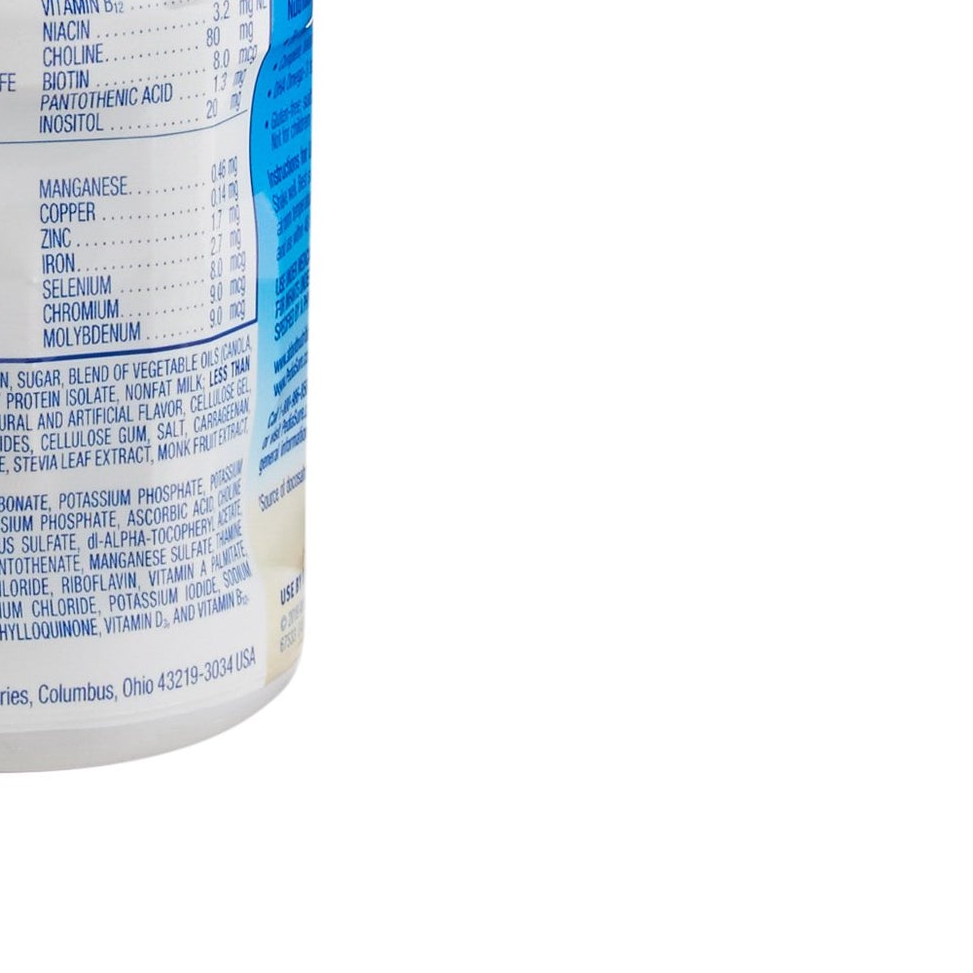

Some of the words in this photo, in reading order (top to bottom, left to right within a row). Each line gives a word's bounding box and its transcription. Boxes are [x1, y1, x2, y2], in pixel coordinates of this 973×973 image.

[43, 20, 90, 42] NIACIN
[43, 44, 103, 67] CHOLINE
[206, 27, 220, 47] 80
[43, 70, 90, 91] BIOTIN
[40, 89, 138, 111] PANTOTHENIC
[141, 83, 173, 103] ACID
[39, 114, 104, 133] INOSITOL
[206, 100, 218, 119] 20
[39, 176, 128, 198] MANGANESE
[40, 202, 95, 223] COPPER
[41, 228, 71, 249] ZINC
[42, 253, 75, 274] IRON
[43, 275, 111, 300] SELENIUM
[43, 299, 119, 324] CHROMIUM
[43, 322, 140, 348] MOLYBDENUM
[17, 369, 64, 389] SUGAR,
[68, 365, 109, 385] BLEND
[114, 363, 129, 381] OF
[133, 354, 197, 377] VEGETABLE
[22, 534, 80, 554] SULFATE,
[38, 682, 118, 704] Columbus,
[123, 677, 154, 697] Ohio
[157, 655, 233, 691] 43219-3034
[236, 646, 256, 671] USA
